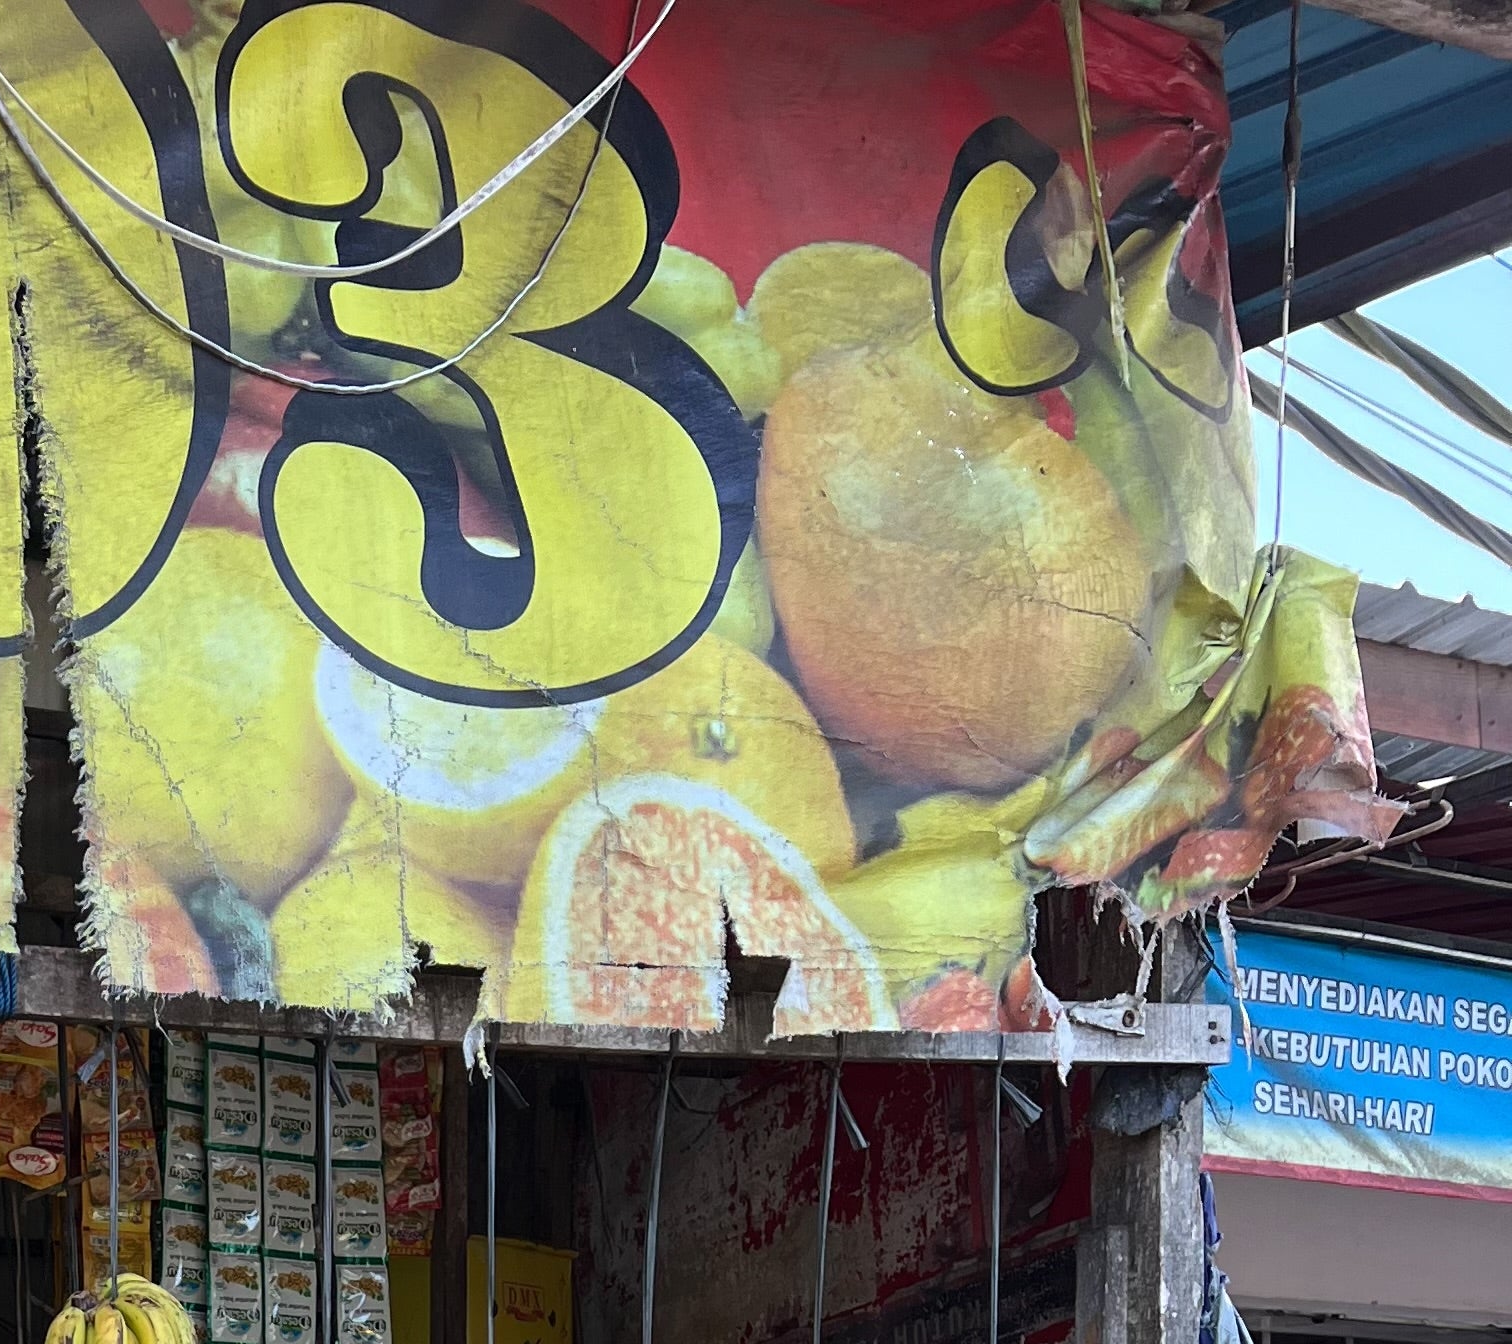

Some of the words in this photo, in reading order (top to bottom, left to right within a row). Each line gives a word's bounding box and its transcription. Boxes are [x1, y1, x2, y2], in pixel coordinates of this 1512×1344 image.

[1233, 967, 1445, 1026] MENYEDIAKAN
[1453, 999, 1512, 1036] SEG
[1253, 1026, 1431, 1079] KEBUTUHAN
[1254, 1081, 1434, 1135] SEHARI-HARI
